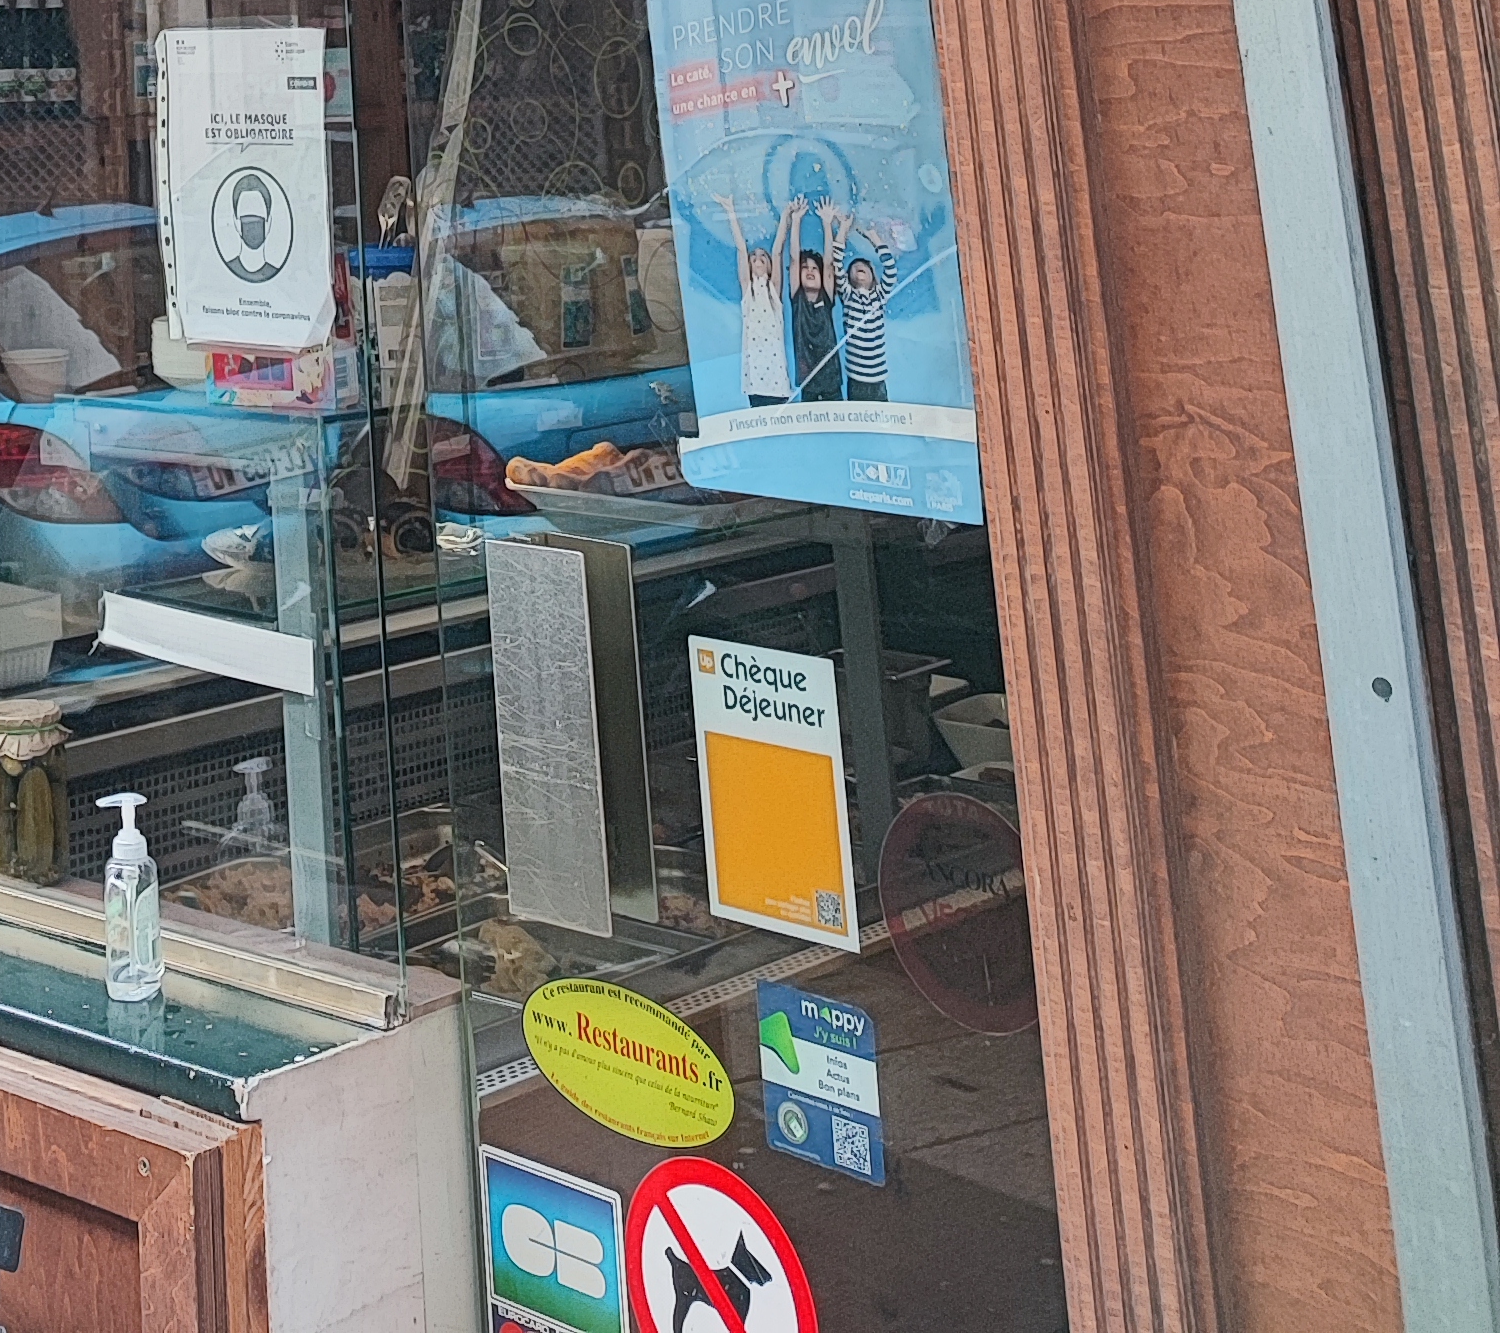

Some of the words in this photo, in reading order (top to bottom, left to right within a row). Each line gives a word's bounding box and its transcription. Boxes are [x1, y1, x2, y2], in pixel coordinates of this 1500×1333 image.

[720, 37, 774, 74] SON
[670, 71, 684, 87] Le
[672, 101, 694, 115] une
[696, 88, 738, 110] chance
[740, 86, 757, 100] en
[210, 114, 228, 126] ICI,
[230, 114, 241, 124] LE
[244, 113, 288, 126] MASQUE
[205, 128, 222, 139] EST
[225, 128, 294, 140] OBLIGATOIRE
[729, 415, 768, 431] J'inscris
[770, 415, 793, 425] mon
[796, 410, 831, 424] enfant
[833, 412, 845, 422] au
[847, 409, 907, 425] catéchisme
[849, 489, 914, 507] cateparis.com
[720, 652, 807, 692] Chèque
[723, 685, 826, 728] Déjeuner
[542, 986, 555, 1001] Ce
[556, 982, 605, 995] restaurant
[607, 987, 622, 1000] est
[624, 992, 691, 1041] recommandé
[690, 1040, 711, 1061] par
[800, 998, 865, 1036] mappy
[813, 1025, 829, 1044] J'y
[830, 1032, 850, 1048] suis
[826, 1054, 848, 1071] Infos
[826, 1068, 850, 1084] Actus
[818, 1079, 836, 1095] Bon
[838, 1085, 861, 1103] plans
